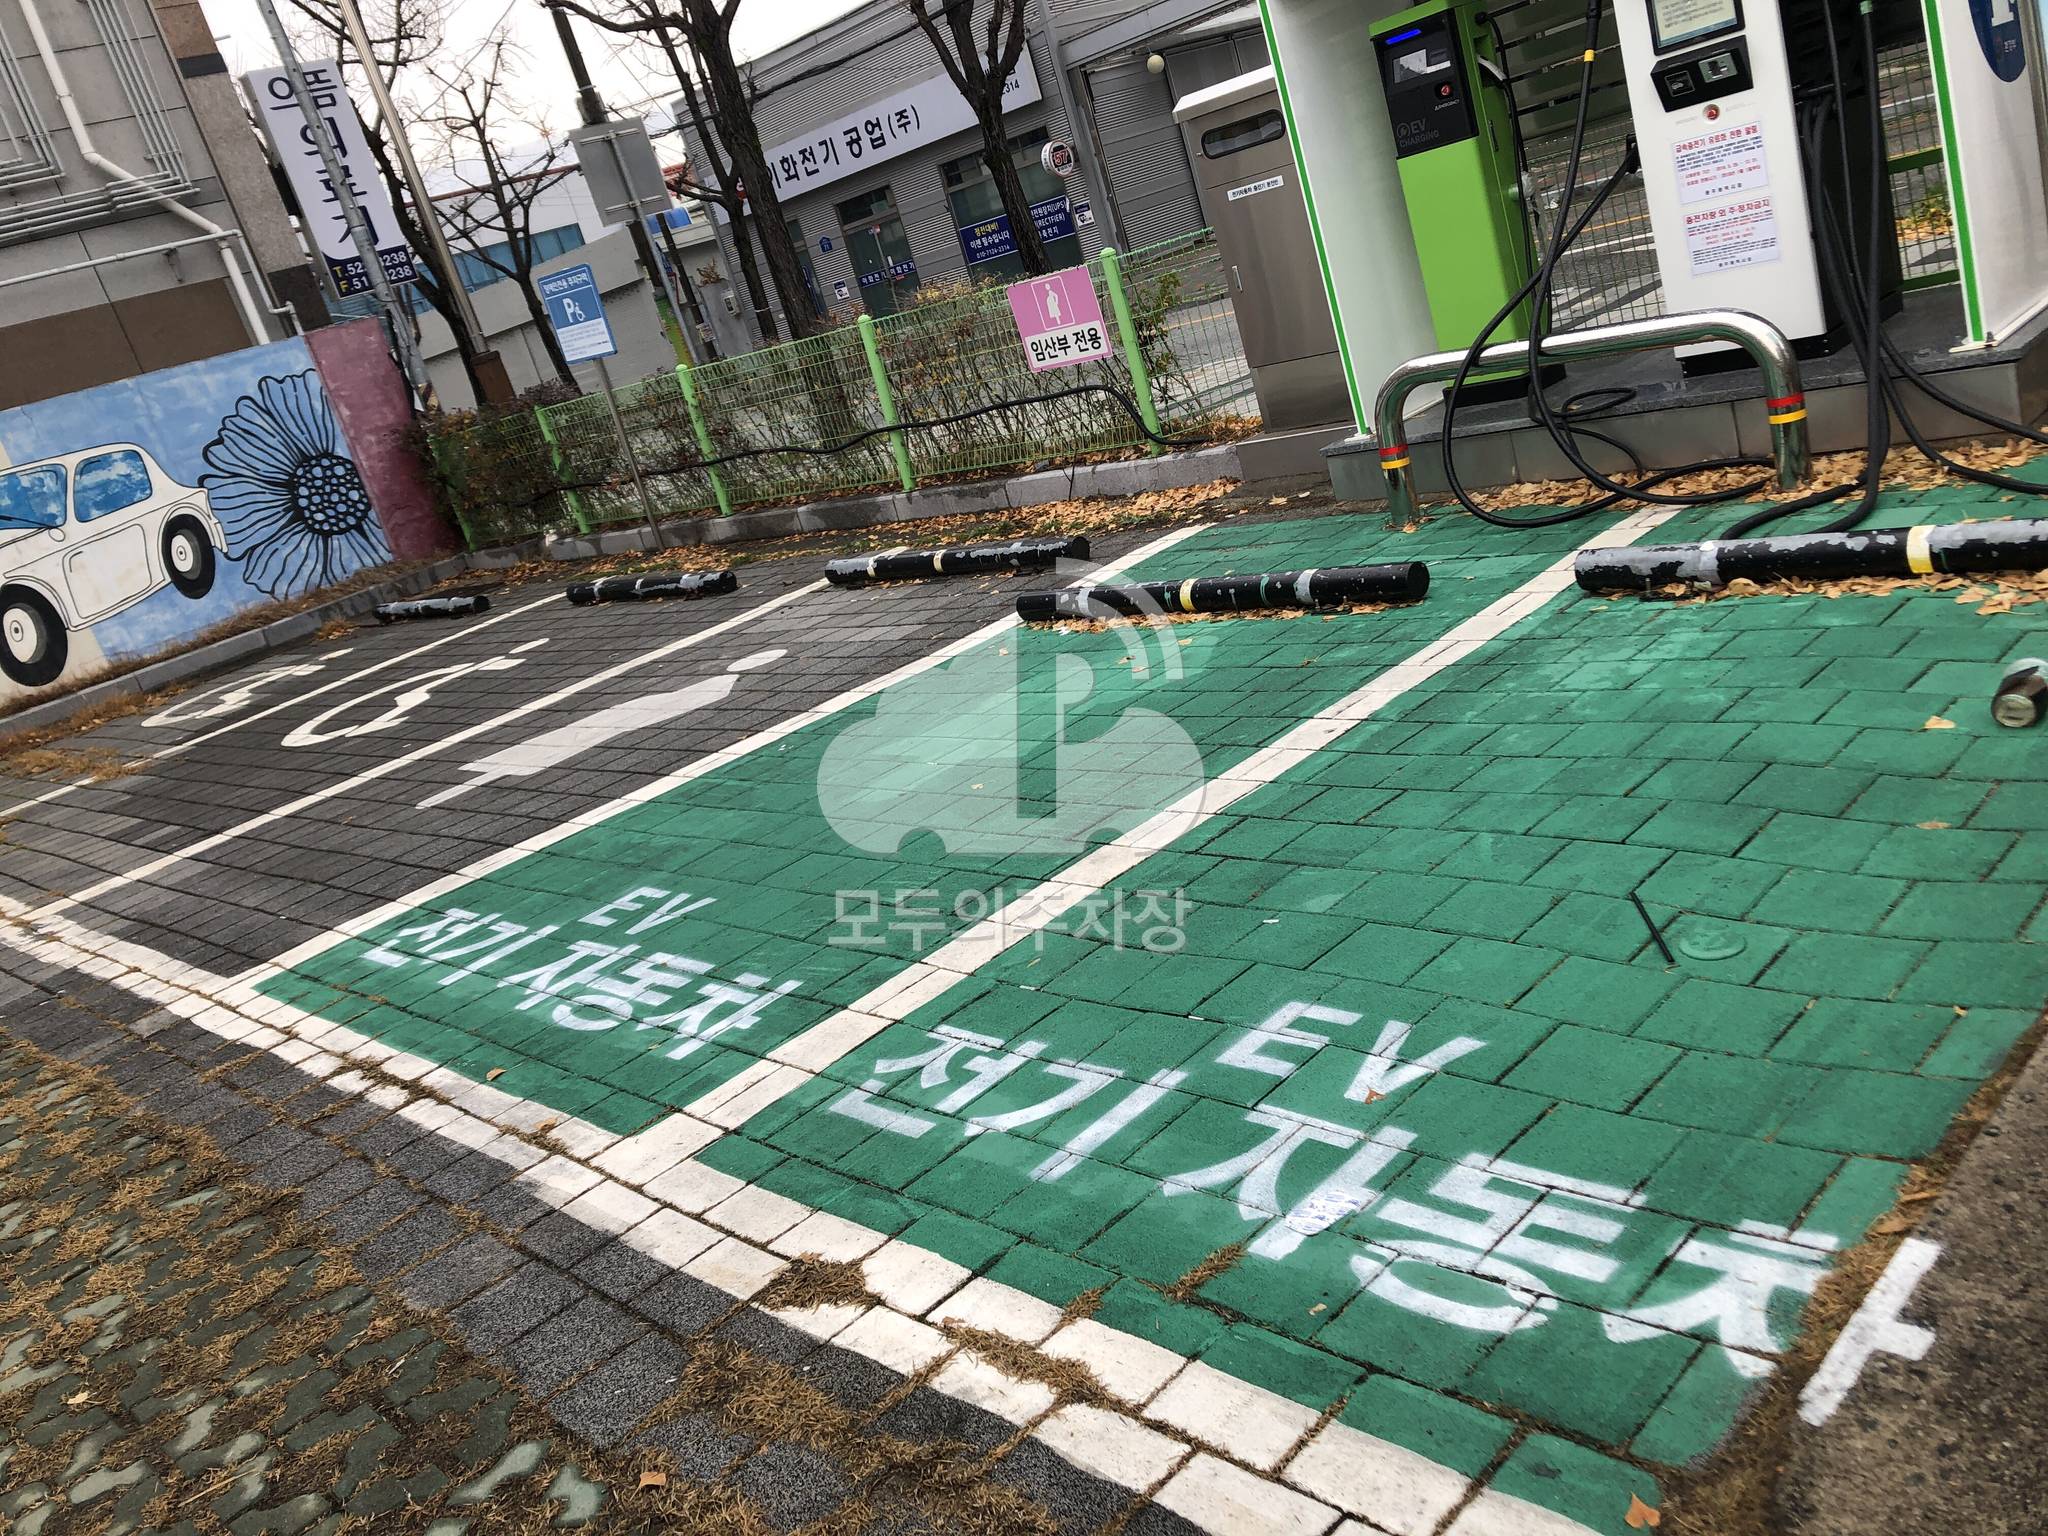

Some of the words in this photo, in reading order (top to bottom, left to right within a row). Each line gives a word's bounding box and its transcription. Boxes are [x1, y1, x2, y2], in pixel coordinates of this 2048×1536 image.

[1400, 130, 1439, 148] CHARGING
[1411, 118, 1426, 134] EV
[1031, 334, 1071, 362] 임산부
[1072, 327, 1102, 353] 전용
[577, 886, 718, 936] EV
[359, 907, 805, 1062] 전기자동차
[1215, 1000, 1487, 1102] EV
